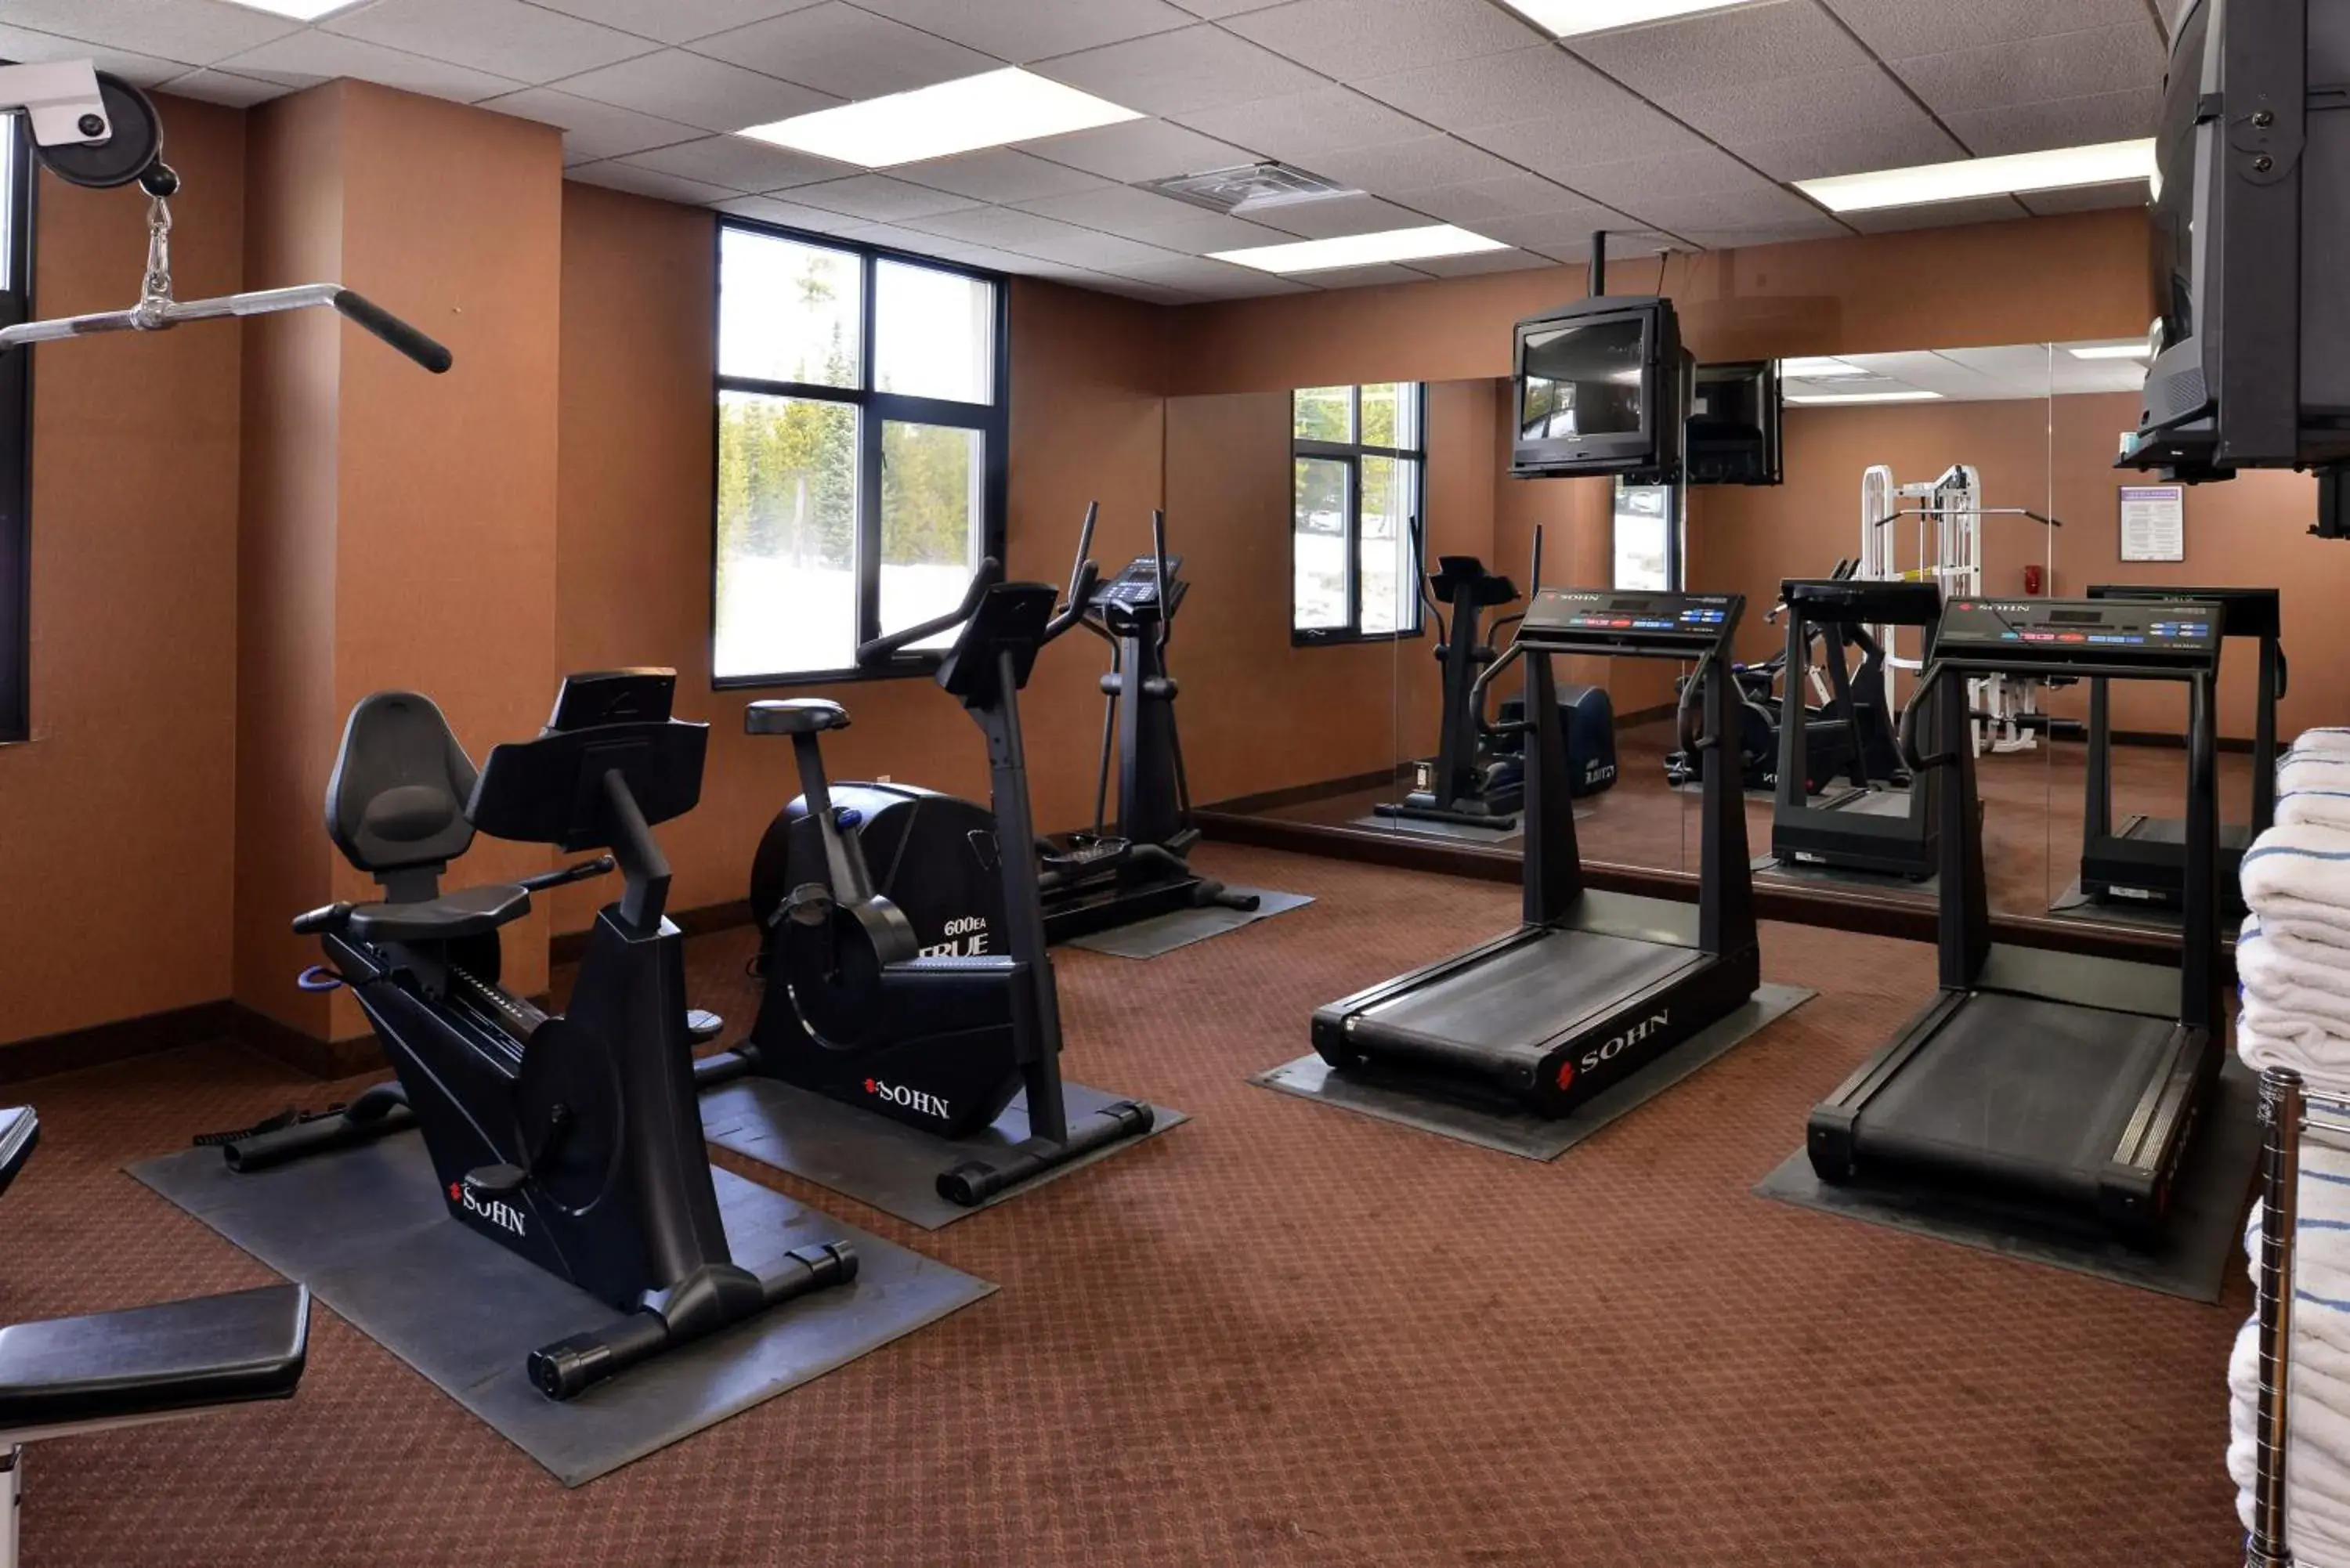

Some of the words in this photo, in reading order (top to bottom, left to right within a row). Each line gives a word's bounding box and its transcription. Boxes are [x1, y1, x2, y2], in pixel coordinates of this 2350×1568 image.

[944, 916, 987, 936] 600EA
[1581, 1008, 1669, 1074] SOHN
[877, 1081, 950, 1119] SOHN
